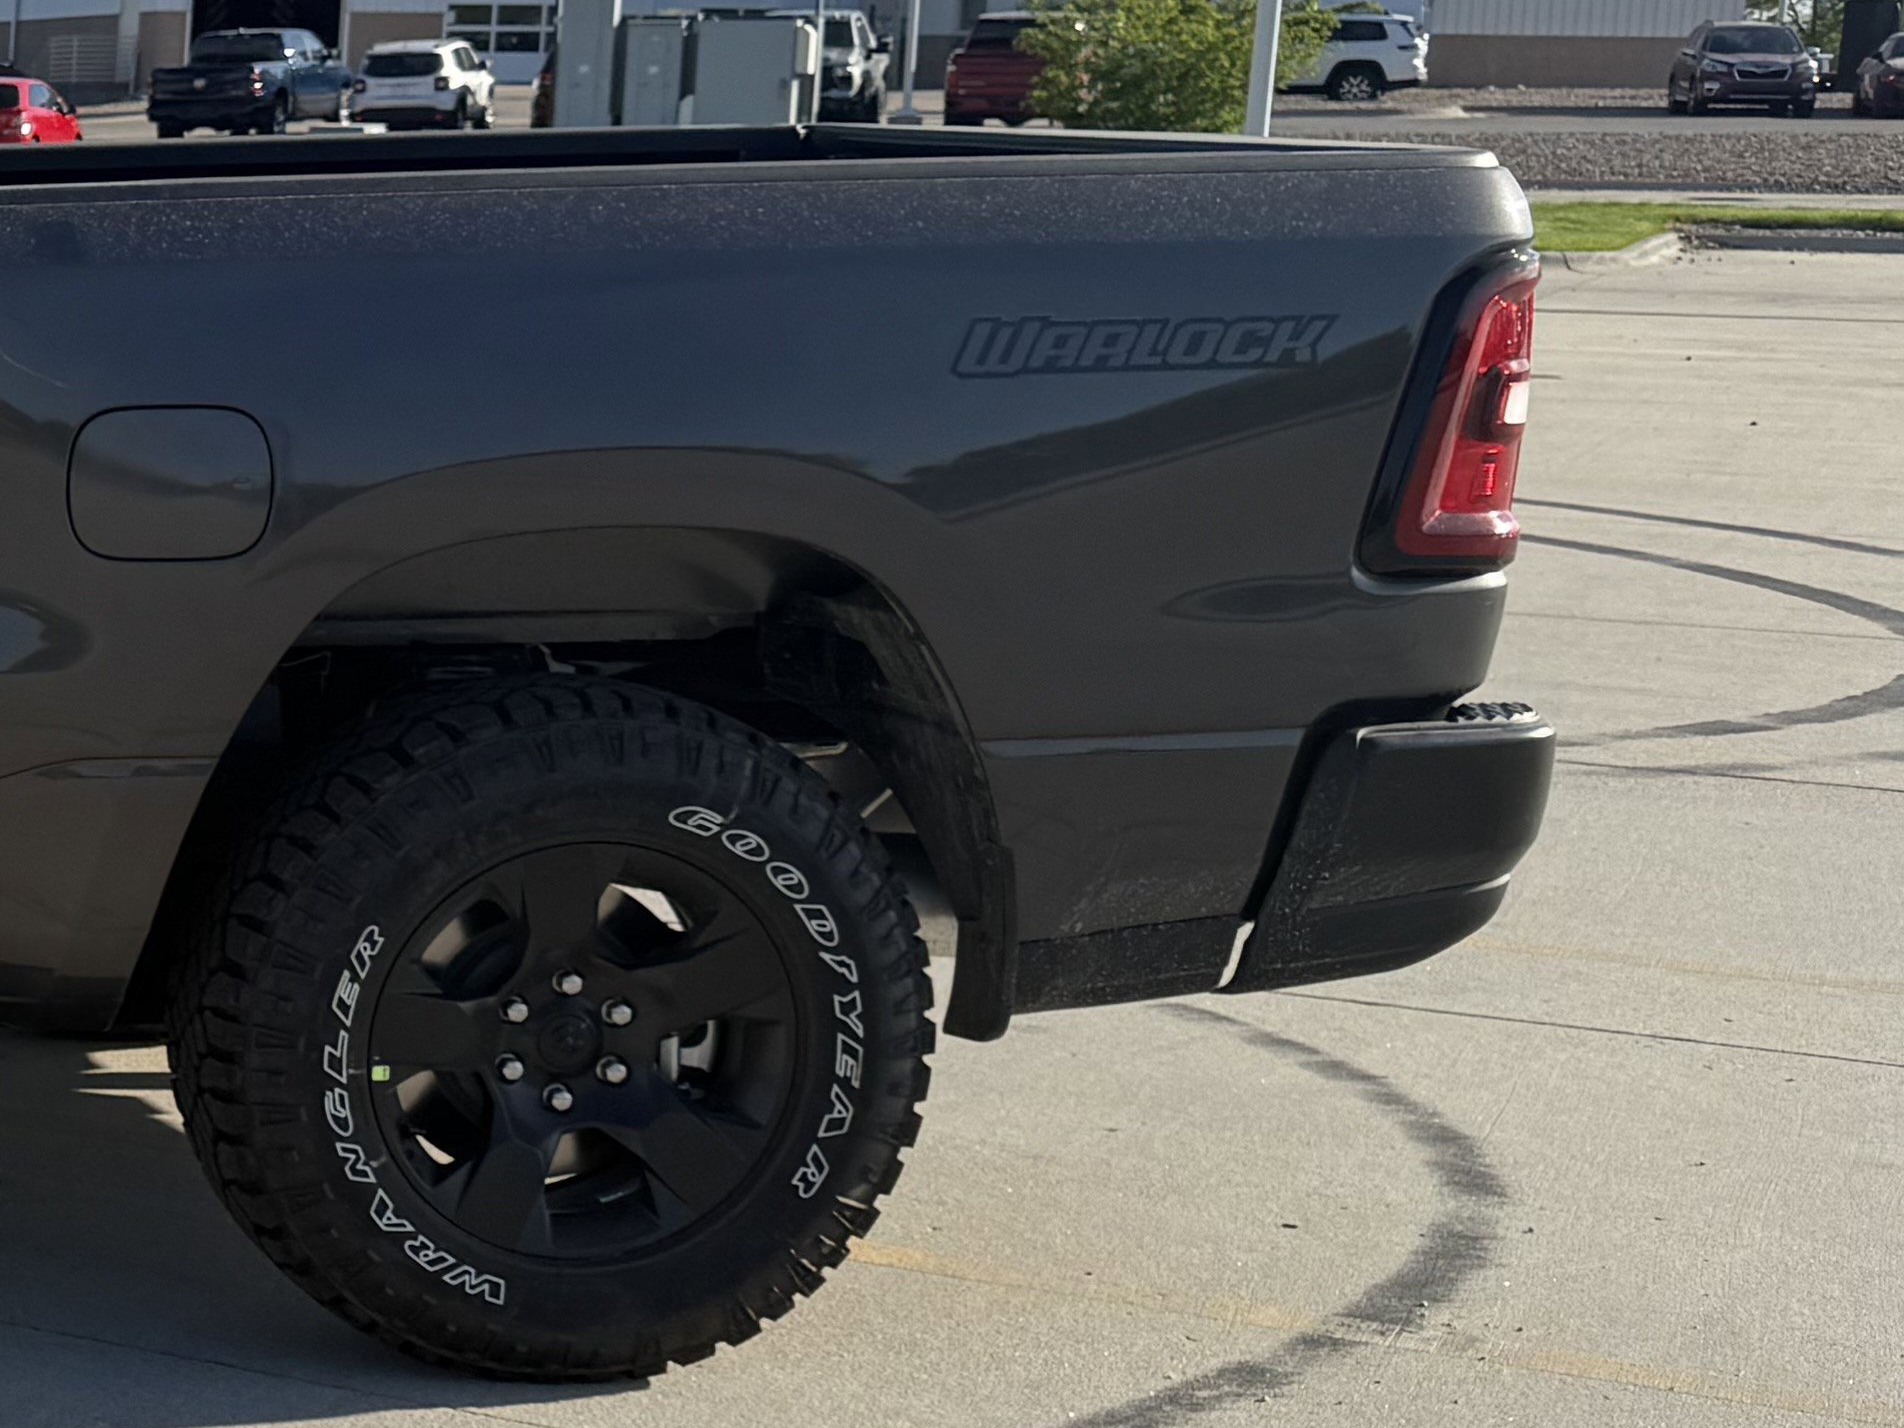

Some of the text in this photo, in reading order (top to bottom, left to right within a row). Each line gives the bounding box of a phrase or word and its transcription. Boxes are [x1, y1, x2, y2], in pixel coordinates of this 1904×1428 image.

[950, 314, 1340, 378] WARLOCK
[323, 924, 505, 1306] WRANGLER
[667, 805, 865, 1200] GOODYEAR
